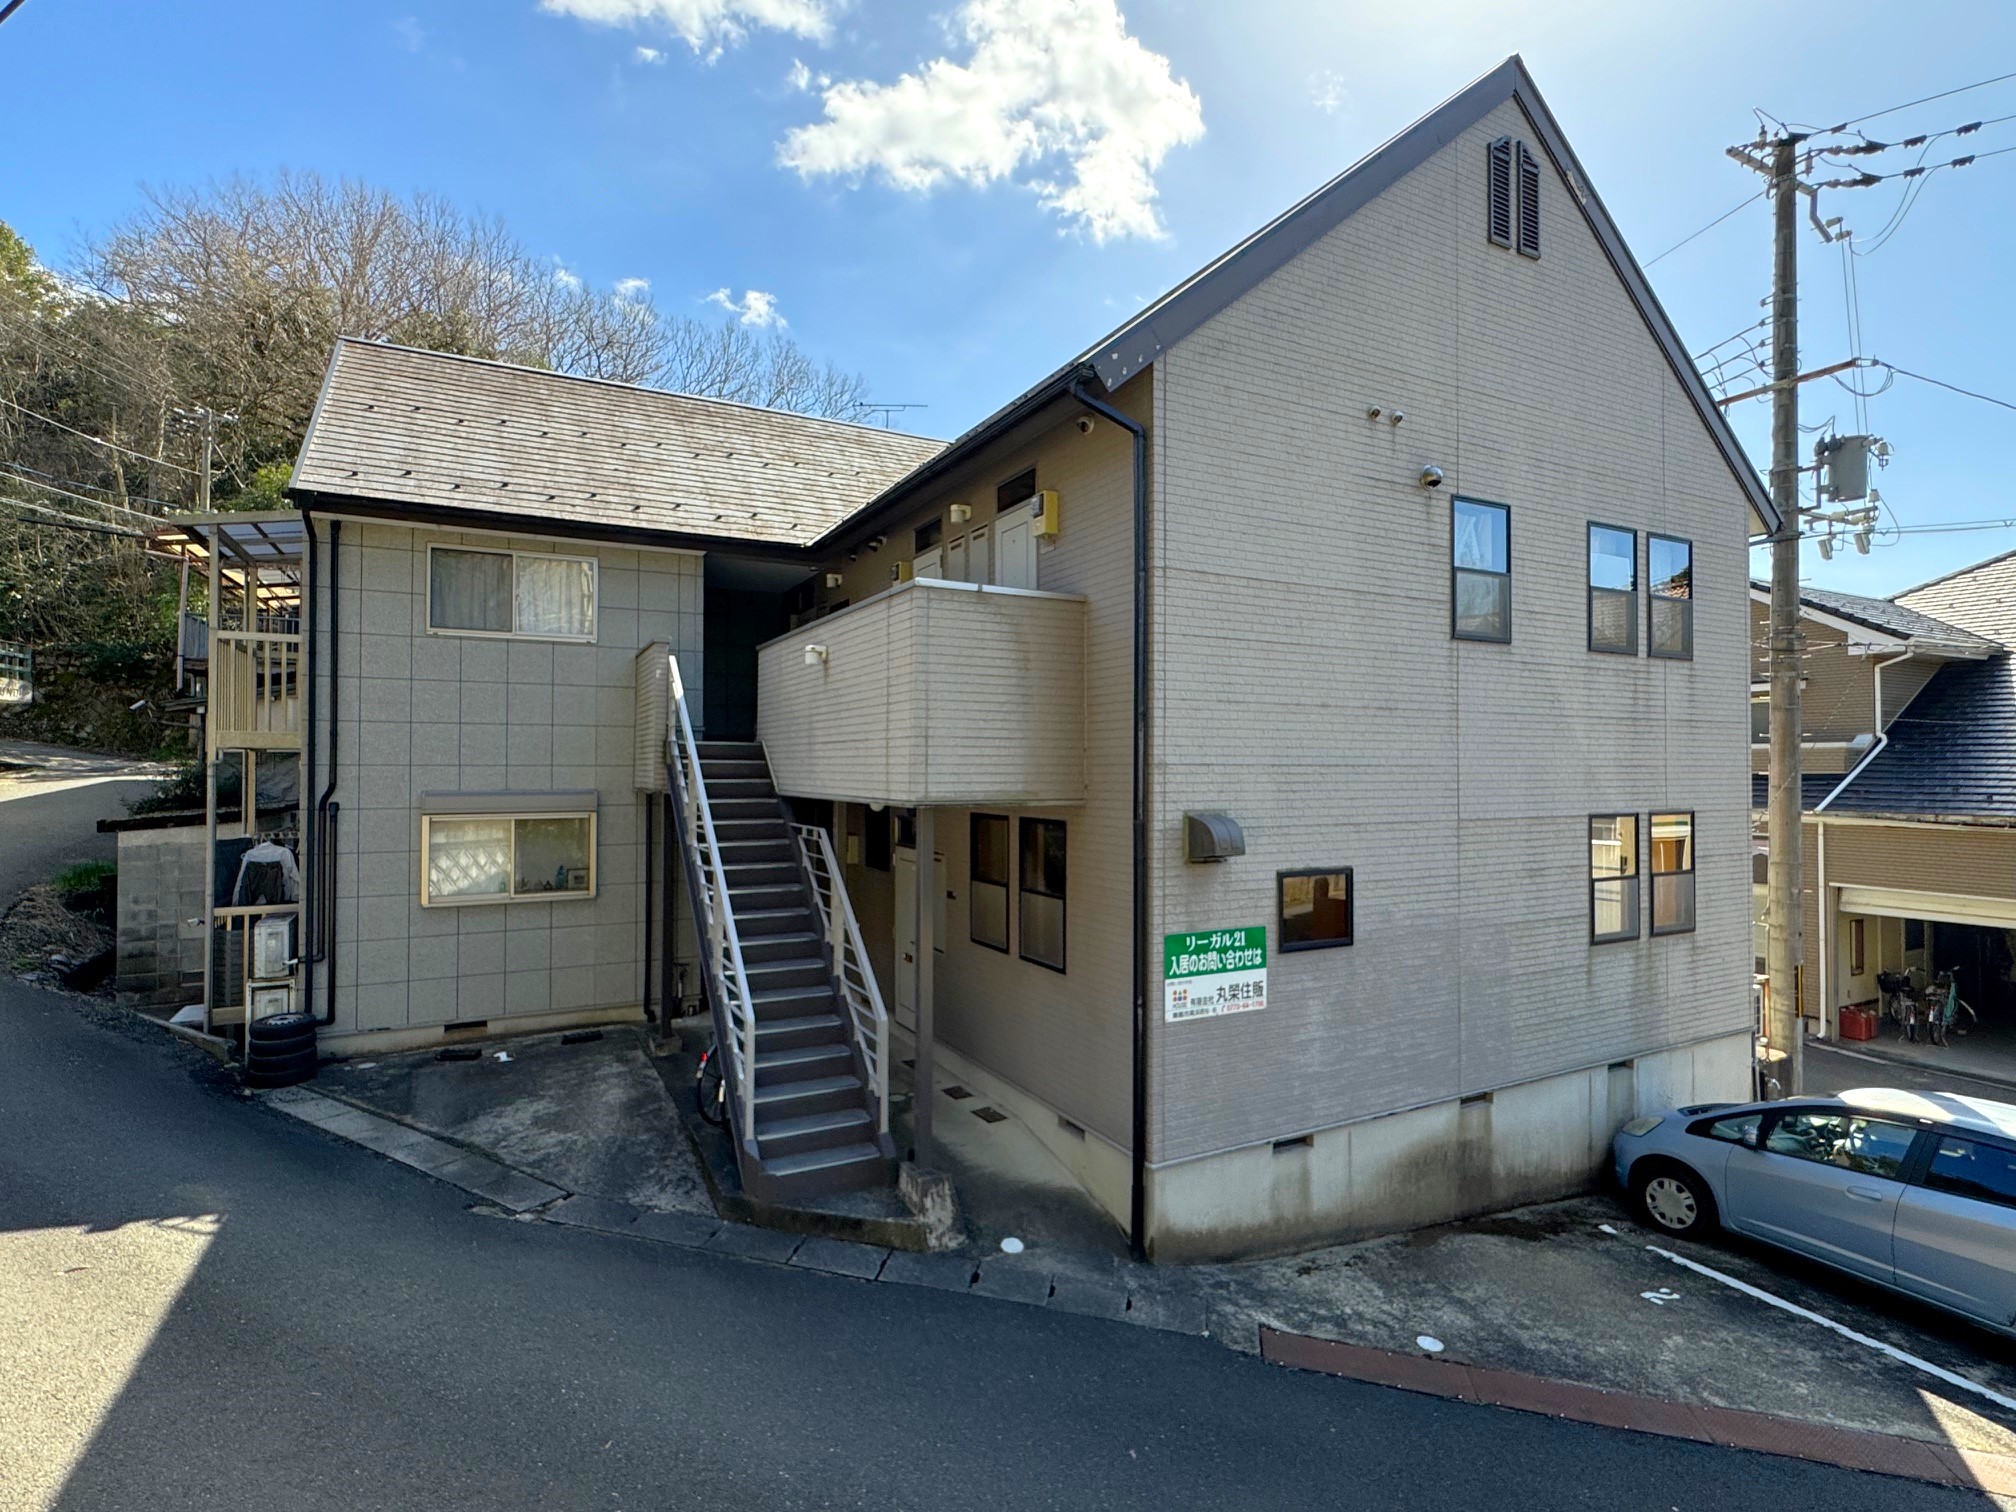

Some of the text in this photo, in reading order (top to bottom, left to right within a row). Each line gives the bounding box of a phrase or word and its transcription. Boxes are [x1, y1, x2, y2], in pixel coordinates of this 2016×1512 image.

[1186, 931, 1245, 951] リーガル21
[1169, 948, 1262, 975] 入居のお問い合わせは
